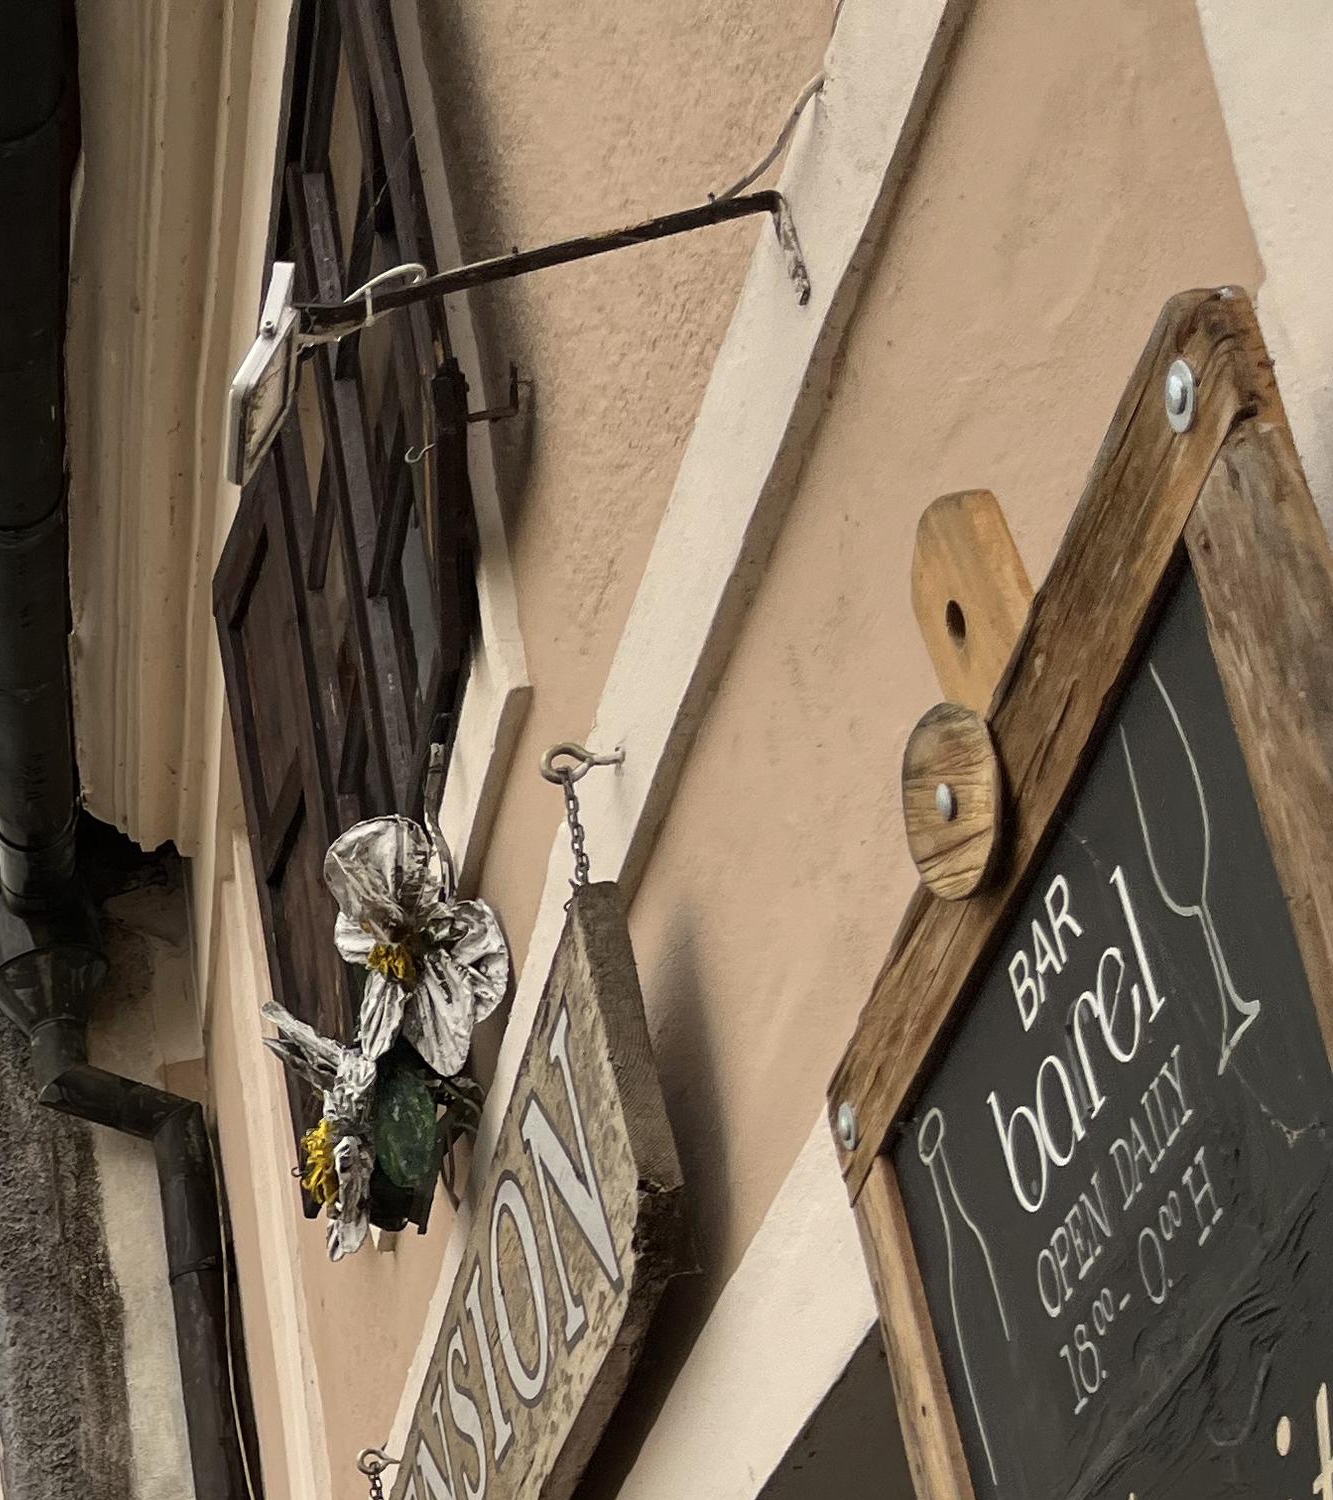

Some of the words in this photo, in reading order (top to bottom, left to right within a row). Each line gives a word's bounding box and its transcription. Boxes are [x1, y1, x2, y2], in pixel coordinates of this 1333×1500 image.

[987, 865, 1166, 1213] barel
[1008, 875, 1082, 1032] BAR
[1037, 1171, 1112, 1318] OPEN
[1109, 1045, 1194, 1212] DAILY
